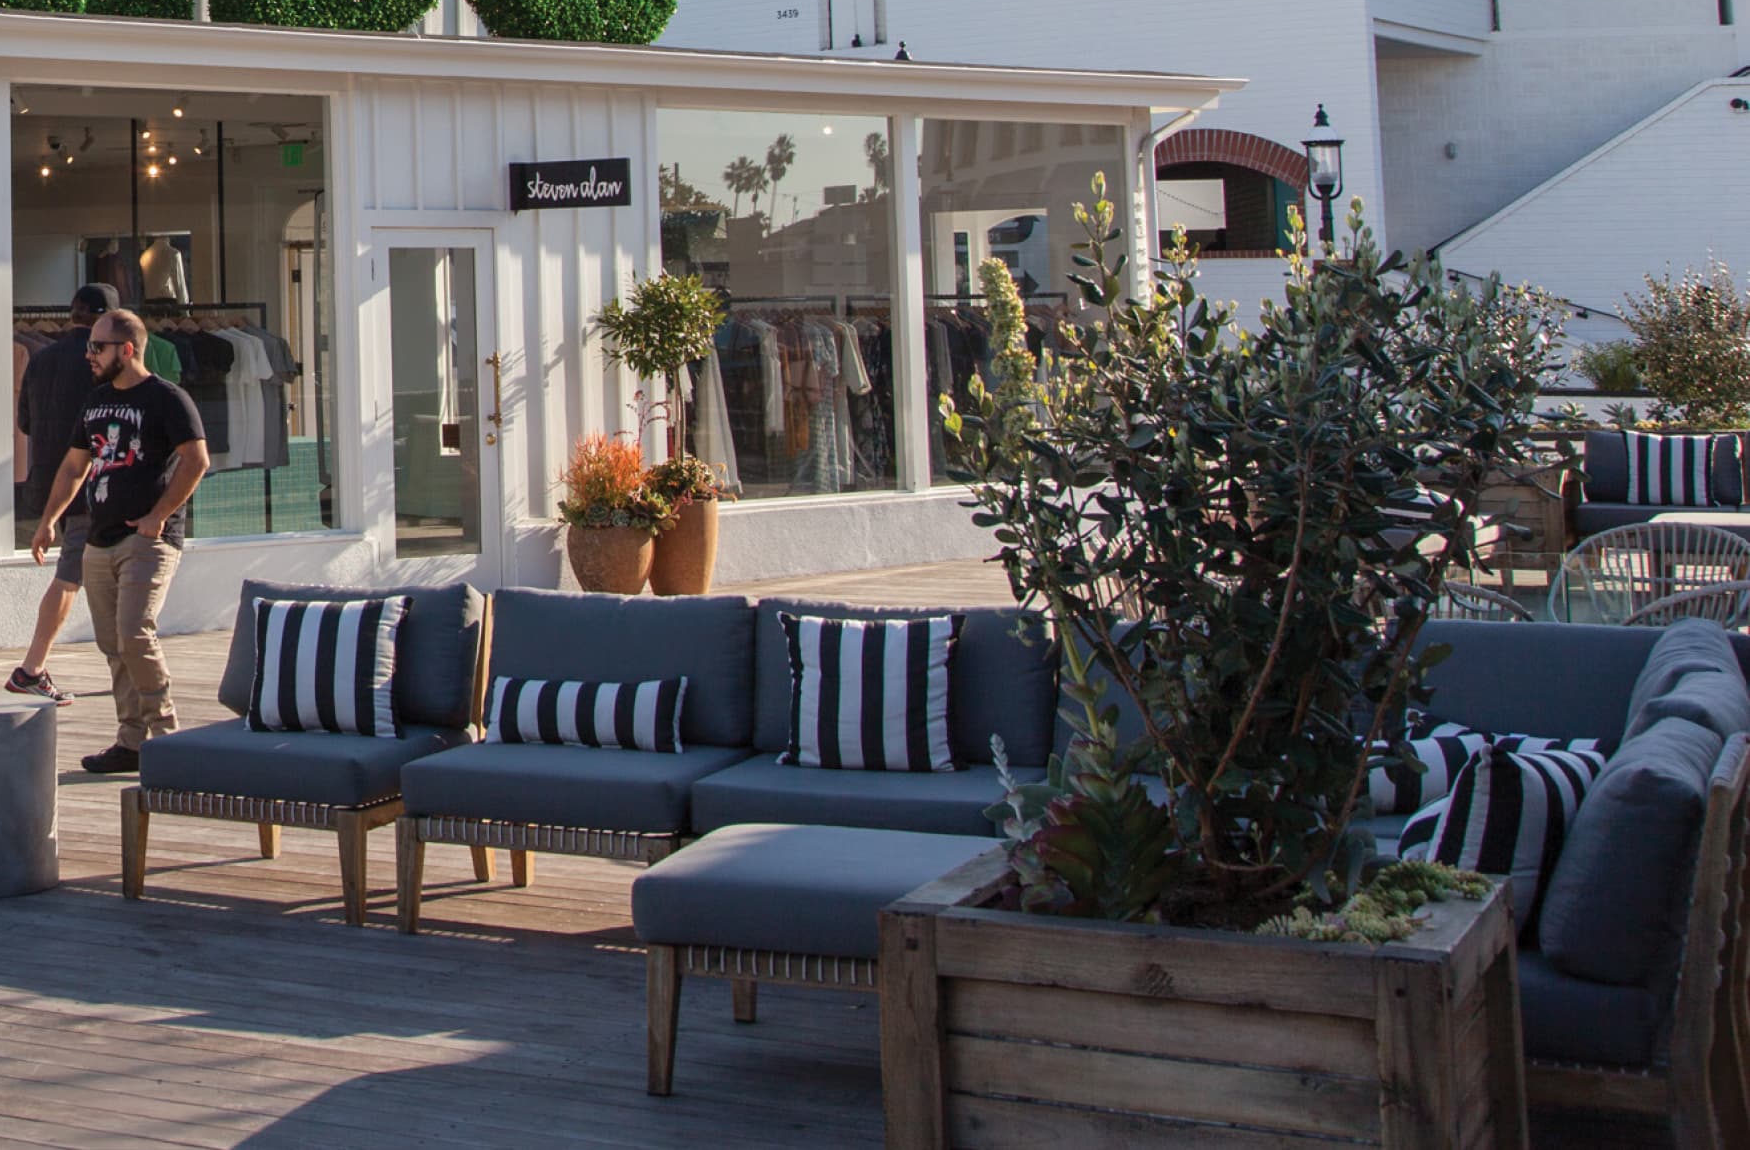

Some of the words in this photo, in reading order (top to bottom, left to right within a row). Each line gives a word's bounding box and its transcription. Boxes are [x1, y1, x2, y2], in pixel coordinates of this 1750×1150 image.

[776, 8, 800, 20] 3439
[526, 170, 579, 202] steven
[580, 165, 623, 201] alan
